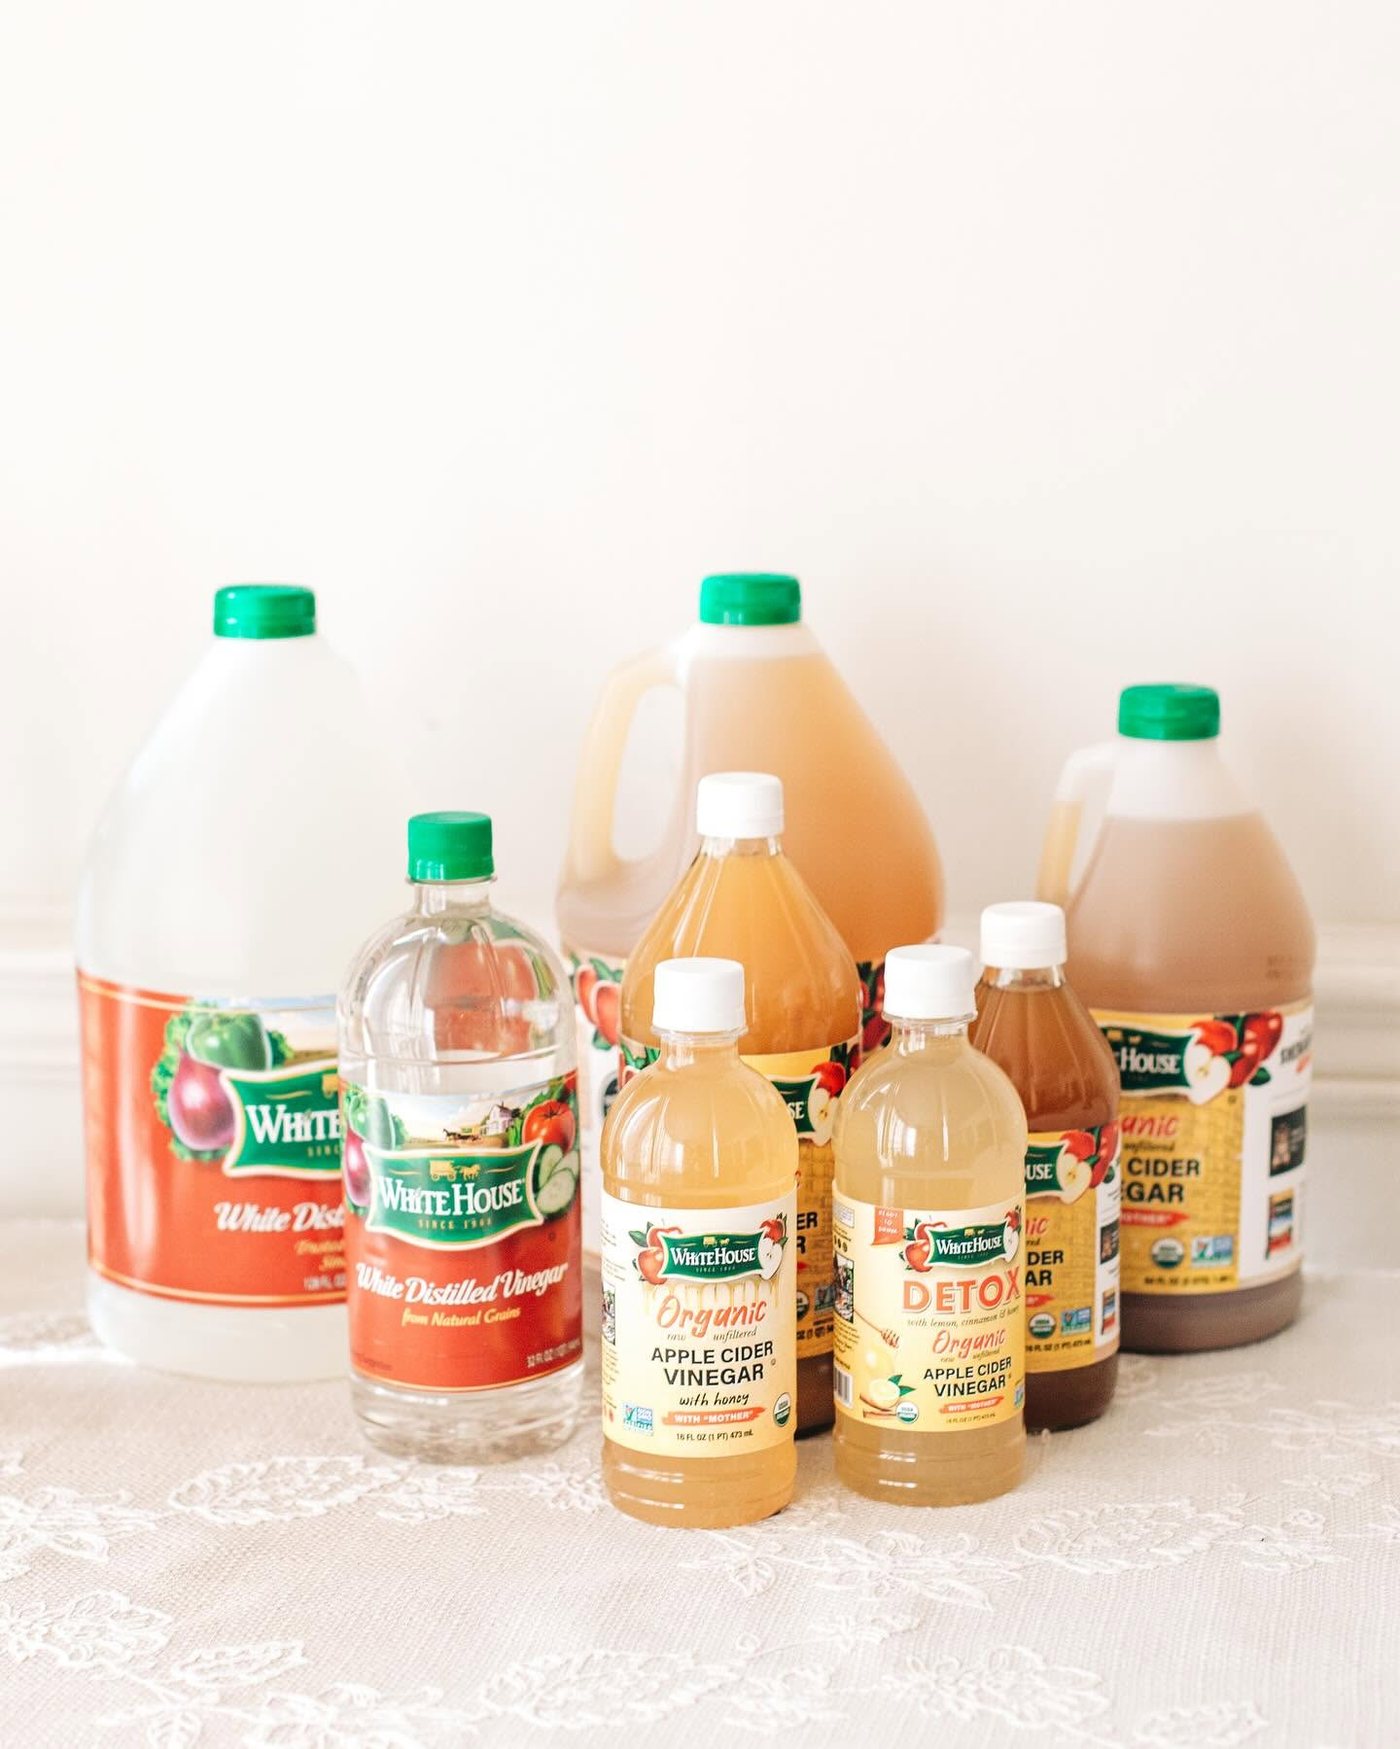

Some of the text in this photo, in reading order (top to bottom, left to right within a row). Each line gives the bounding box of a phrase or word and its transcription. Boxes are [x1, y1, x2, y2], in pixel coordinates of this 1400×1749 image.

[1127, 1157, 1200, 1177] CIDER
[1120, 1181, 1184, 1203] GAR
[213, 1201, 292, 1232] White
[355, 1262, 404, 1299] White
[404, 1275, 501, 1306] Distilled
[500, 1263, 569, 1297] Vinegar
[903, 1265, 1021, 1315] DETOX
[402, 1306, 521, 1328] from Natural Grains
[656, 1295, 768, 1338] Organic
[713, 1327, 758, 1343] unfiltered
[932, 1328, 1006, 1359] Organic
[651, 1341, 774, 1365] APPLE CIDER
[664, 1363, 764, 1387] VINEGAR
[923, 1356, 1012, 1380] APPLE CIDER
[934, 1374, 1006, 1397] VINEGAR
[679, 1392, 749, 1406] with honey
[674, 1414, 701, 1423] WITH
